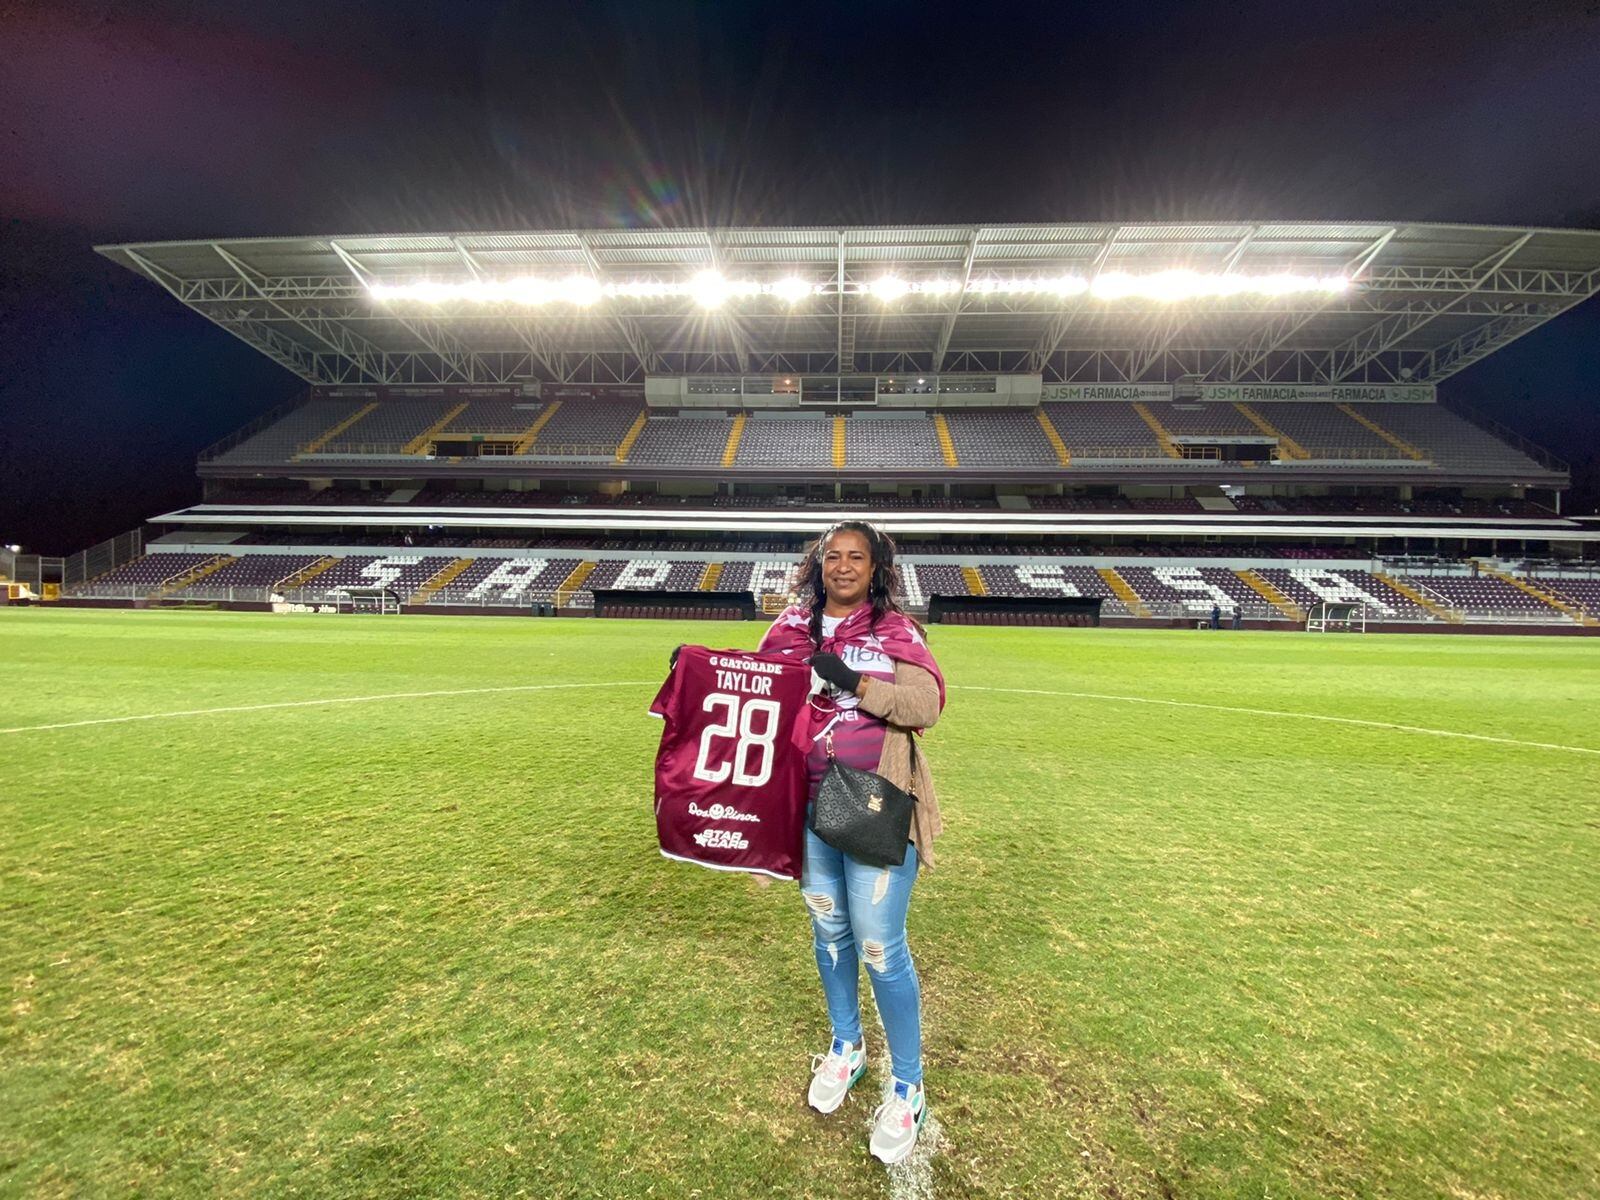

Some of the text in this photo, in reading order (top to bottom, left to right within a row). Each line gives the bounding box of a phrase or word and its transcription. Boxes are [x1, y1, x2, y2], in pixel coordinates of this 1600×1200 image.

[1050, 387, 1081, 399] JSM
[1083, 387, 1140, 399] FARMACIA
[1208, 387, 1240, 399] JSM
[1242, 387, 1298, 400] FARMACIA
[1331, 388, 1387, 400] FARMACIA
[1404, 388, 1435, 400] JSM
[719, 657, 783, 675] GATORADE
[715, 669, 773, 696] TAYLOR
[693, 692, 780, 787] 28
[723, 806, 761, 822] Pinos
[703, 829, 743, 841] STAR
[706, 839, 749, 849] CARS
